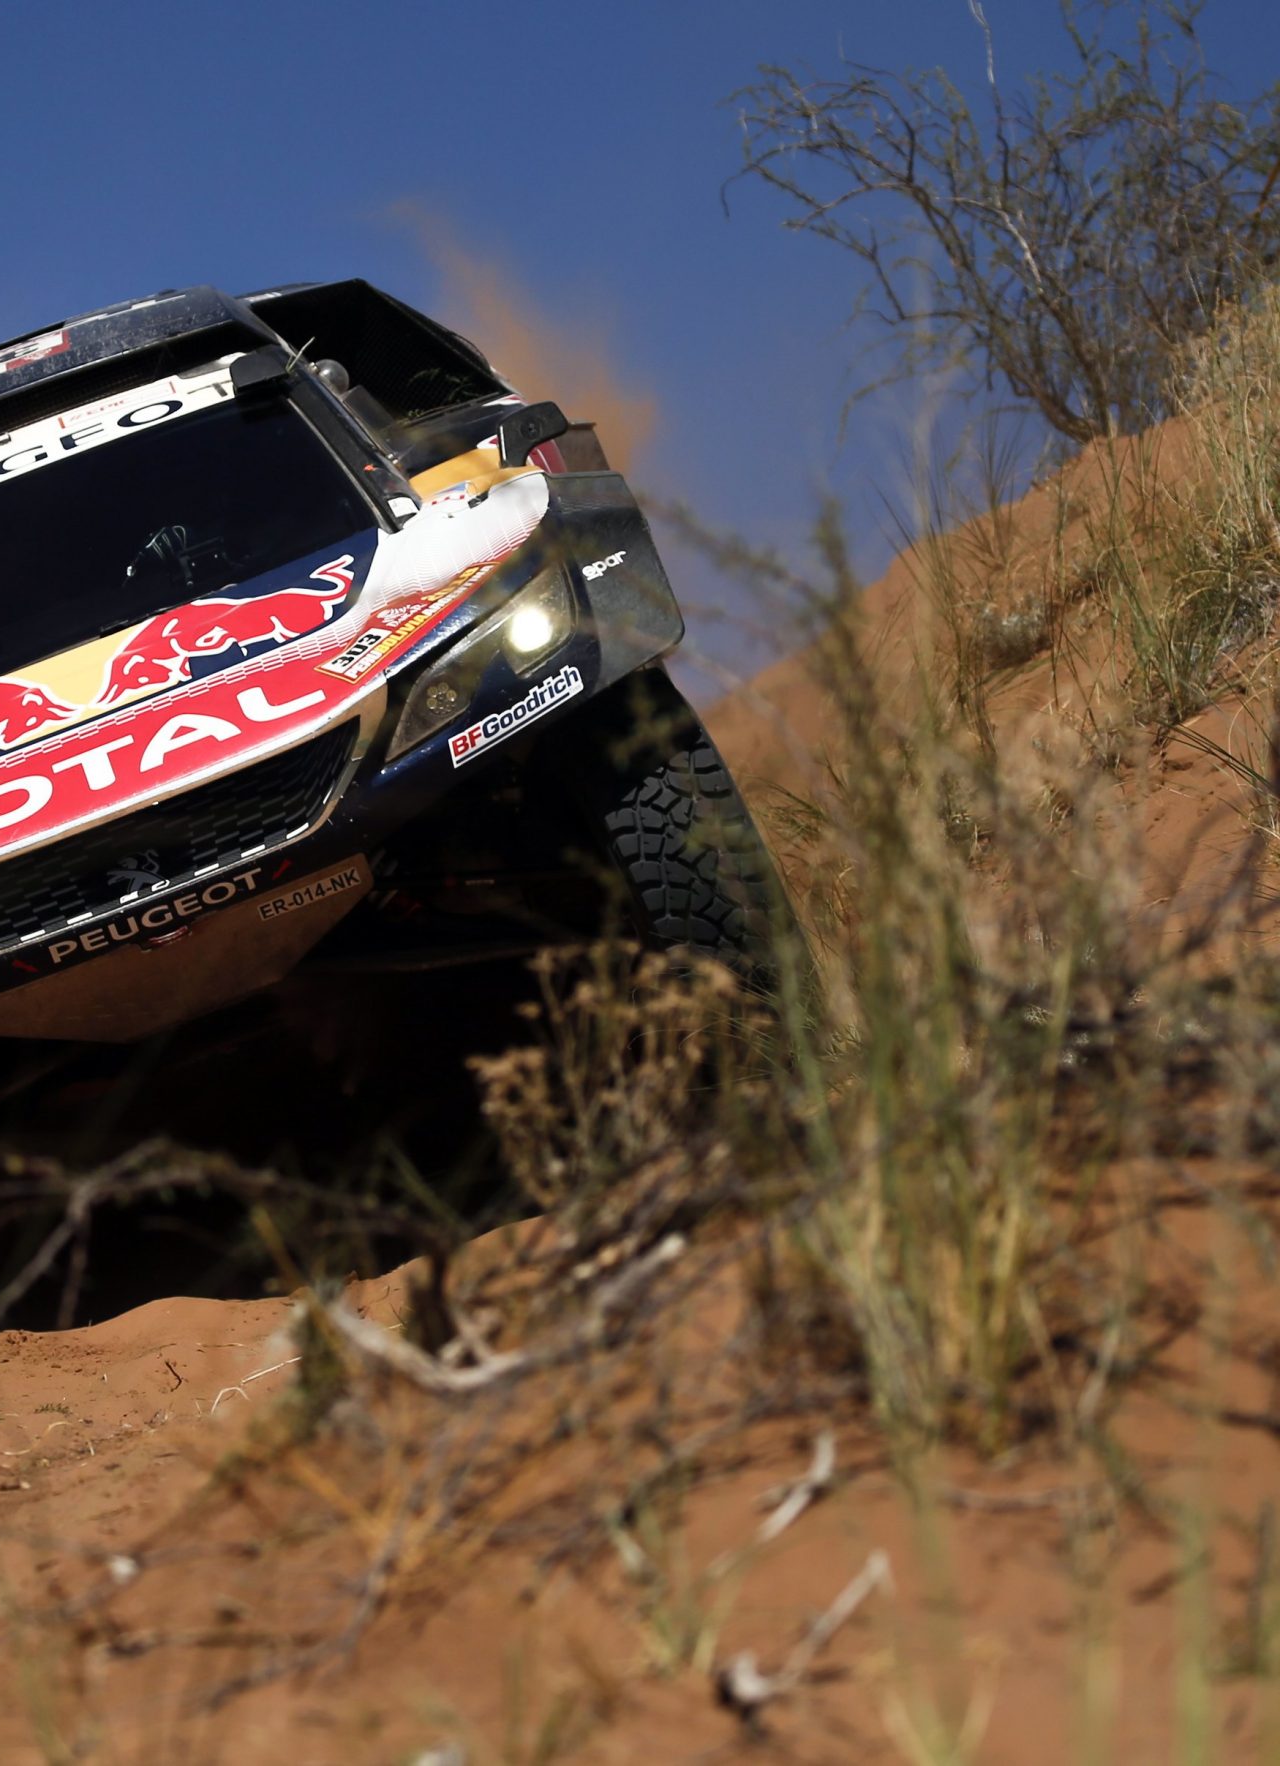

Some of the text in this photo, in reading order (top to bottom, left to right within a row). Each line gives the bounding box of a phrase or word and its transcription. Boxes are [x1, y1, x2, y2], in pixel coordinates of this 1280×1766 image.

[332, 634, 381, 667] 303
[452, 668, 579, 757] BFGoodrich
[48, 868, 262, 963] PEUGEOT
[259, 869, 360, 920] ER-014-NK
